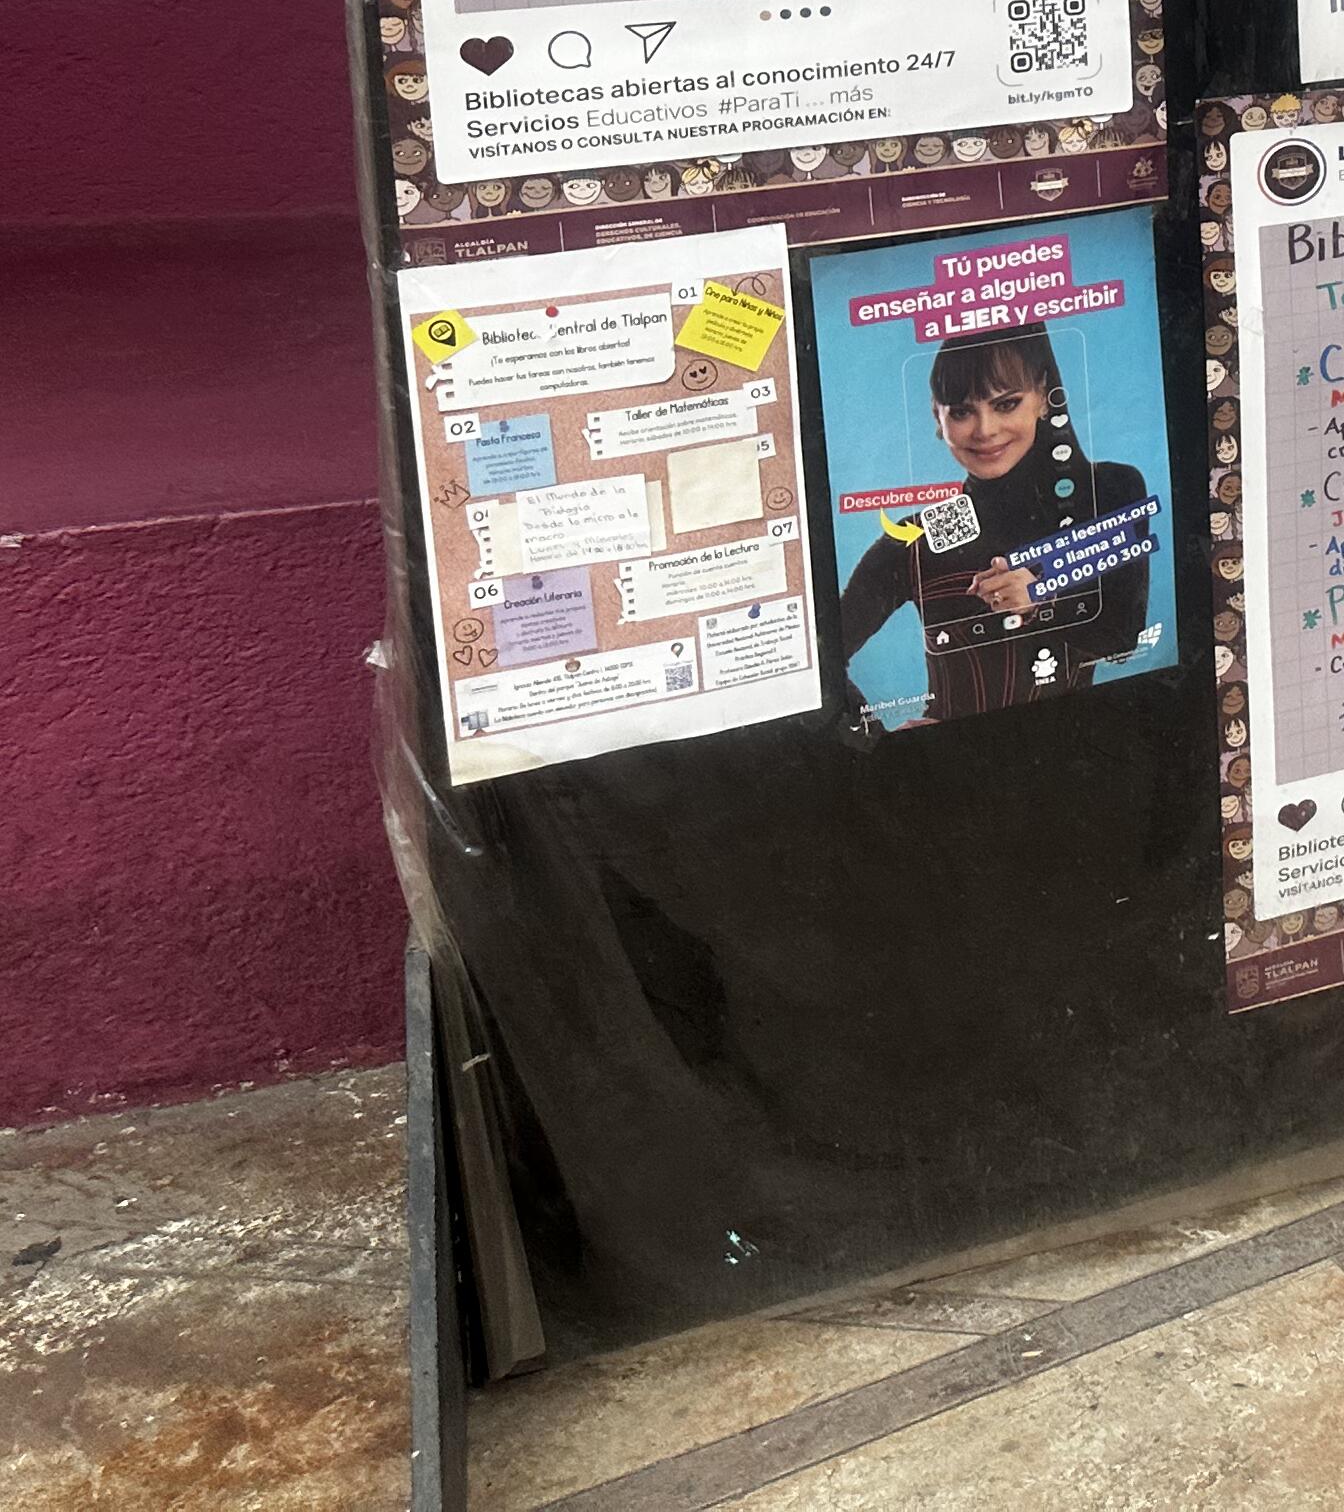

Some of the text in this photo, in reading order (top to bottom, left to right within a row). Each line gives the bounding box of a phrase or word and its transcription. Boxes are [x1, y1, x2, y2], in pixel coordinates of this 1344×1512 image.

[464, 49, 957, 112] Bibliotecas abiertas al conocimiento 24/7
[466, 84, 875, 140] Servicios Educativos #ParaTi más
[468, 106, 891, 160] VISÍTANOS O CONSULTA NUESTRA PROGRAMACIÓN EN:
[942, 242, 1065, 280] Tú puedes
[678, 286, 698, 299] 01
[858, 270, 1066, 321] enseñar a alguien
[924, 285, 1119, 338] a LEER y escribir
[625, 396, 729, 422] Taller de Matemáticas
[750, 386, 771, 399] 03
[843, 485, 960, 511] Descubre cómo
[771, 522, 794, 538] 07
[1009, 498, 1160, 568] Entra a: leermx.org
[1053, 530, 1127, 570] o llama al
[1035, 539, 1153, 597] 800 00 60 300
